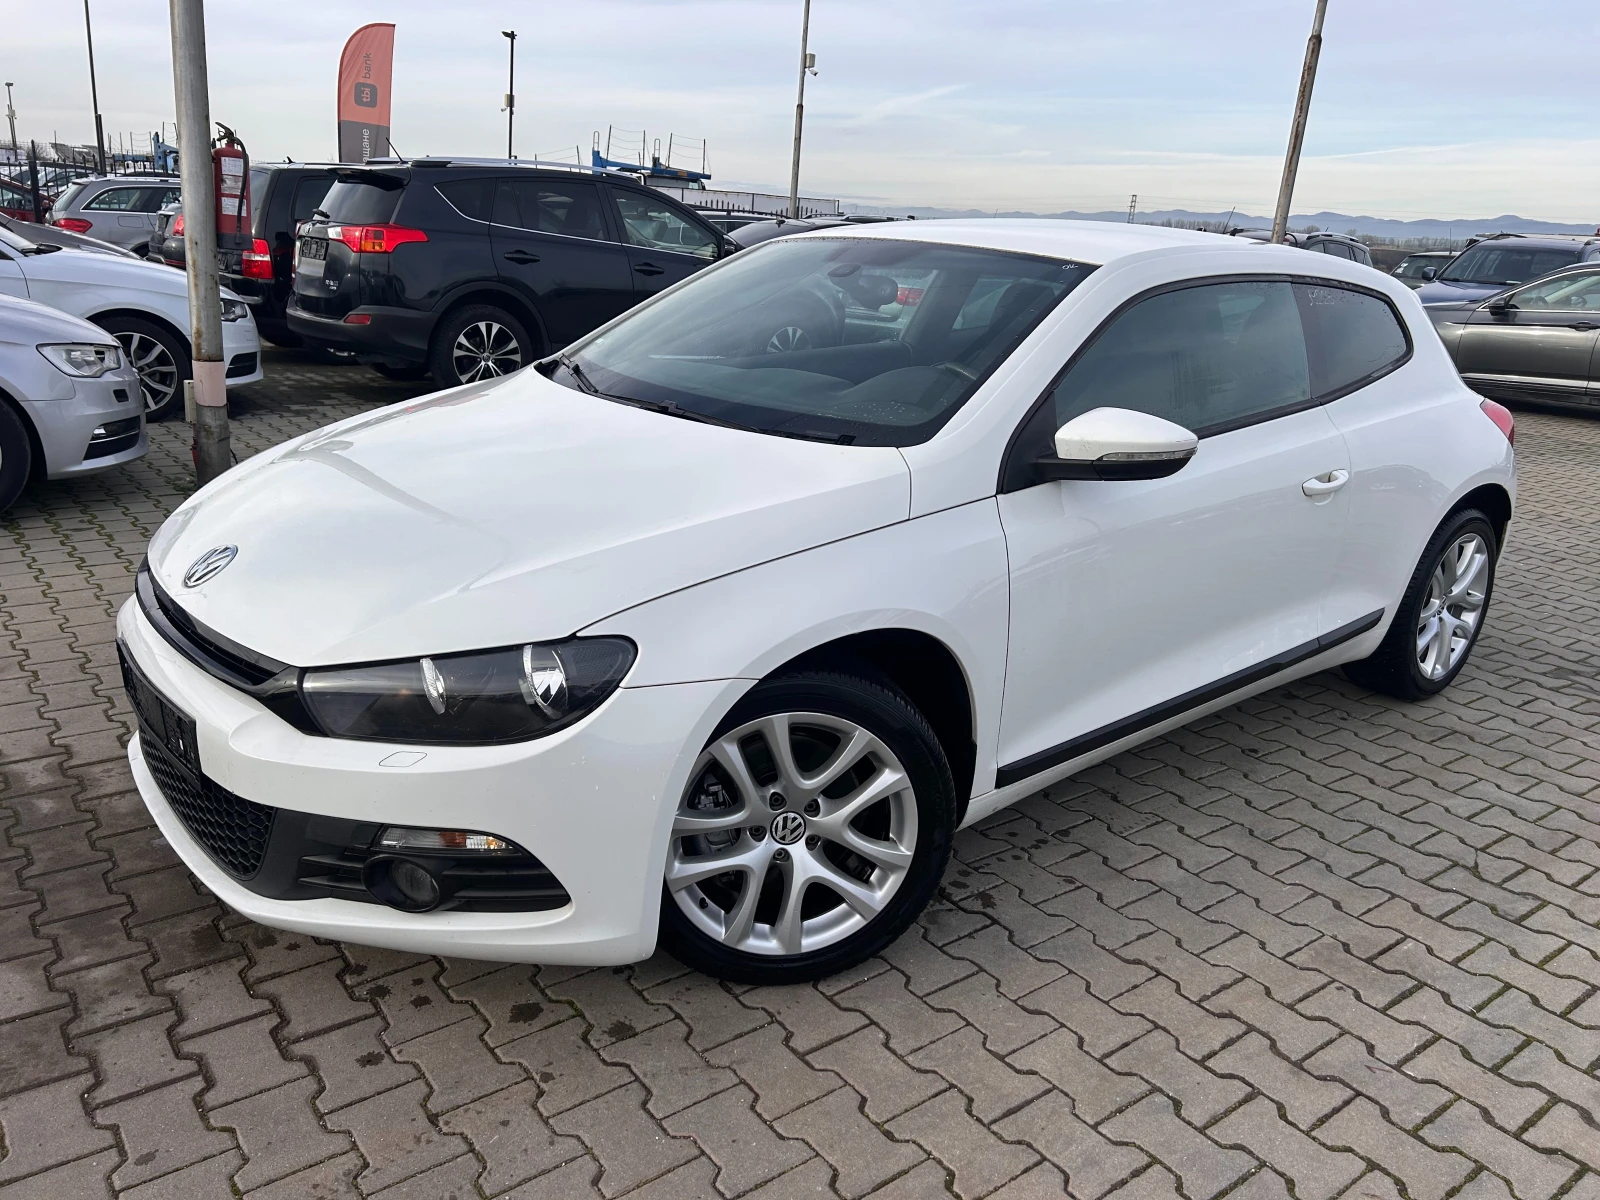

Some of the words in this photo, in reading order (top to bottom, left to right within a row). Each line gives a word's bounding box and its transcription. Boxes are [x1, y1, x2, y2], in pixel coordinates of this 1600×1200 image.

[362, 52, 372, 80] bank
[361, 87, 371, 103] tbi
[362, 128, 371, 166] ащане
[771, 811, 806, 845] VW
